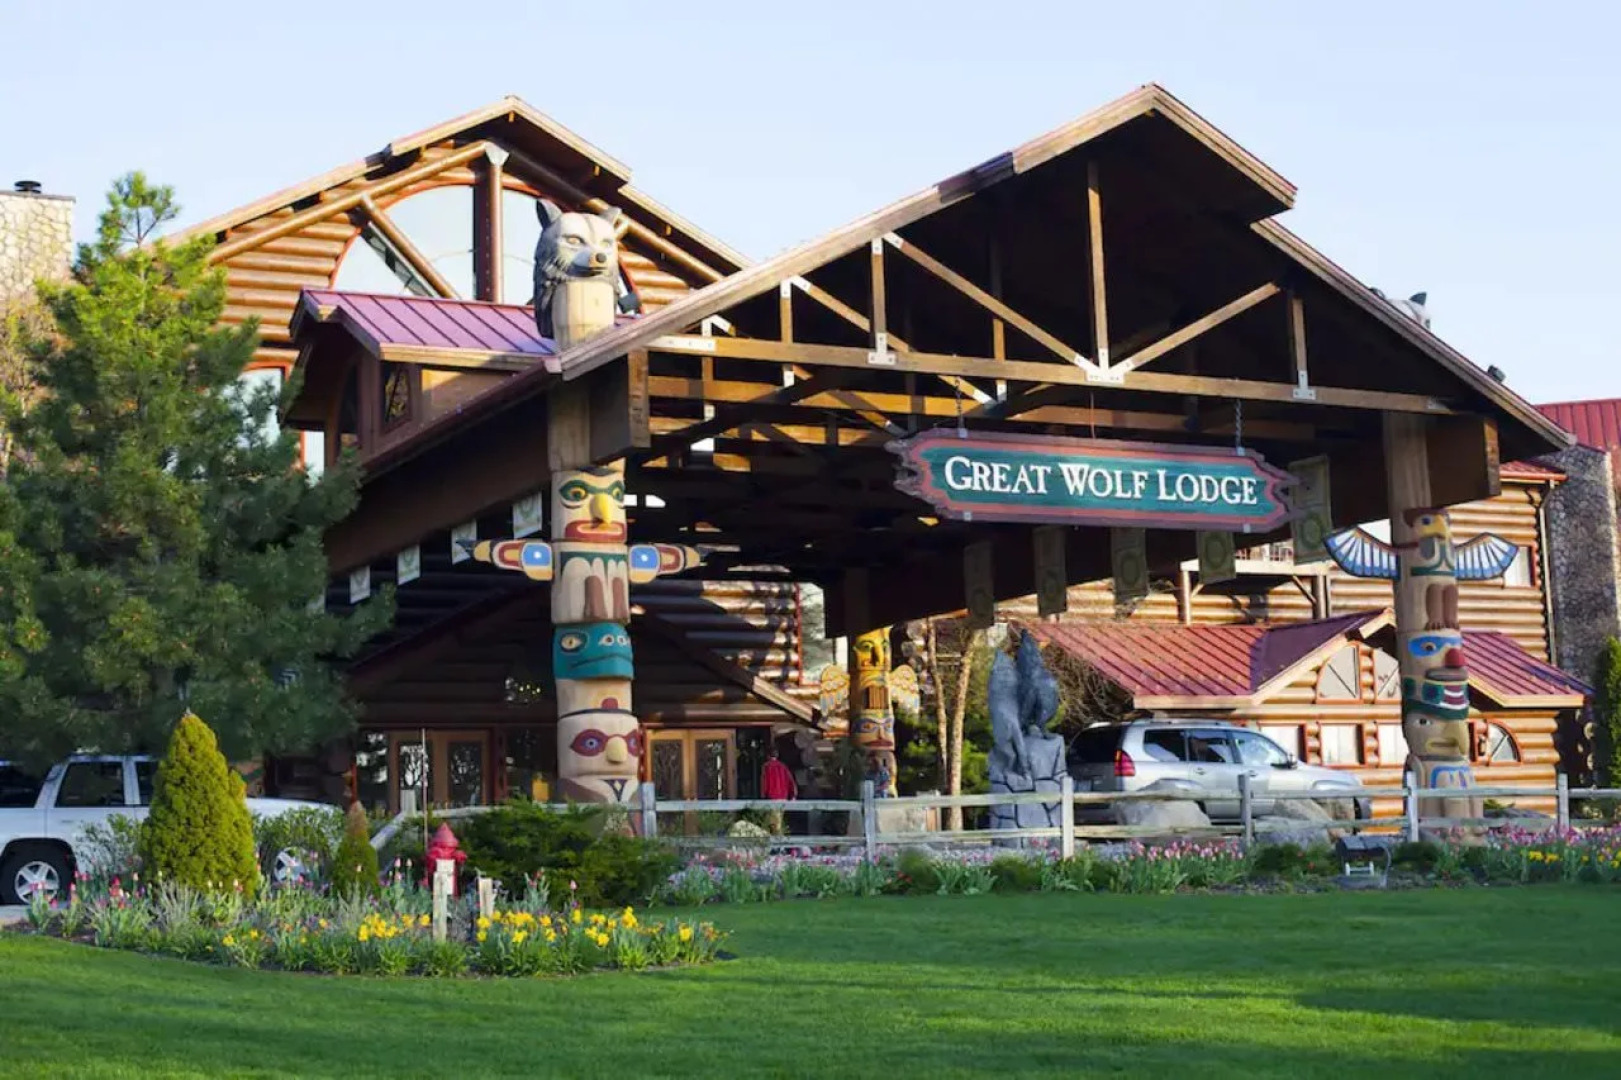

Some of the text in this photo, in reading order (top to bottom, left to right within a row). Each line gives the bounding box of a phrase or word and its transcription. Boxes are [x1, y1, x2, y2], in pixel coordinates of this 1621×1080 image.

[944, 456, 1257, 505] GREAT WOLF LODGE
